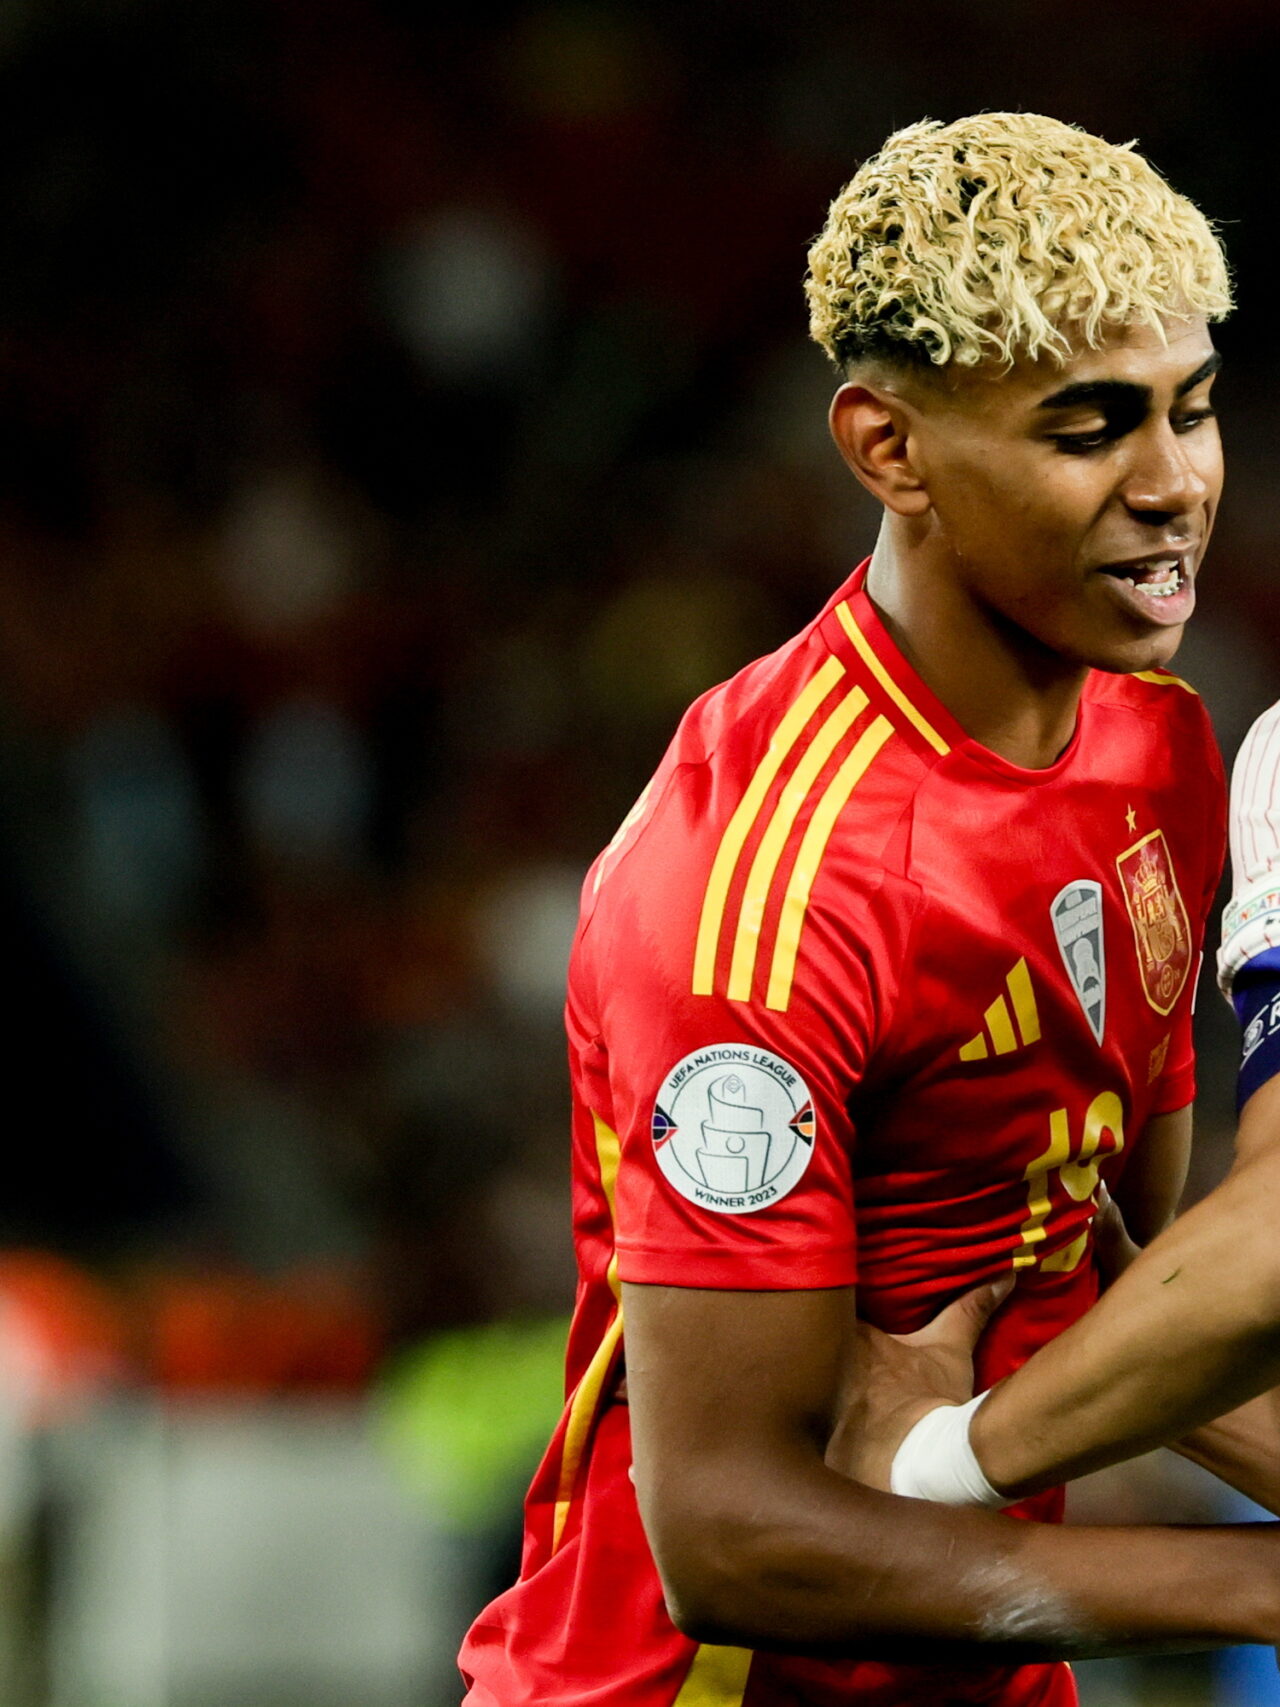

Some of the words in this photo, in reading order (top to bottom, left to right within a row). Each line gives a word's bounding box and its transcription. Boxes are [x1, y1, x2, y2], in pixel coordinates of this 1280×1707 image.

[668, 1064, 695, 1090] UEFA
[693, 1049, 750, 1068] NATIONS
[753, 1053, 798, 1088] LEAGUE
[694, 1186, 746, 1208] WINNER
[747, 1185, 779, 1206] 2023
[1012, 1090, 1125, 1273] 19
